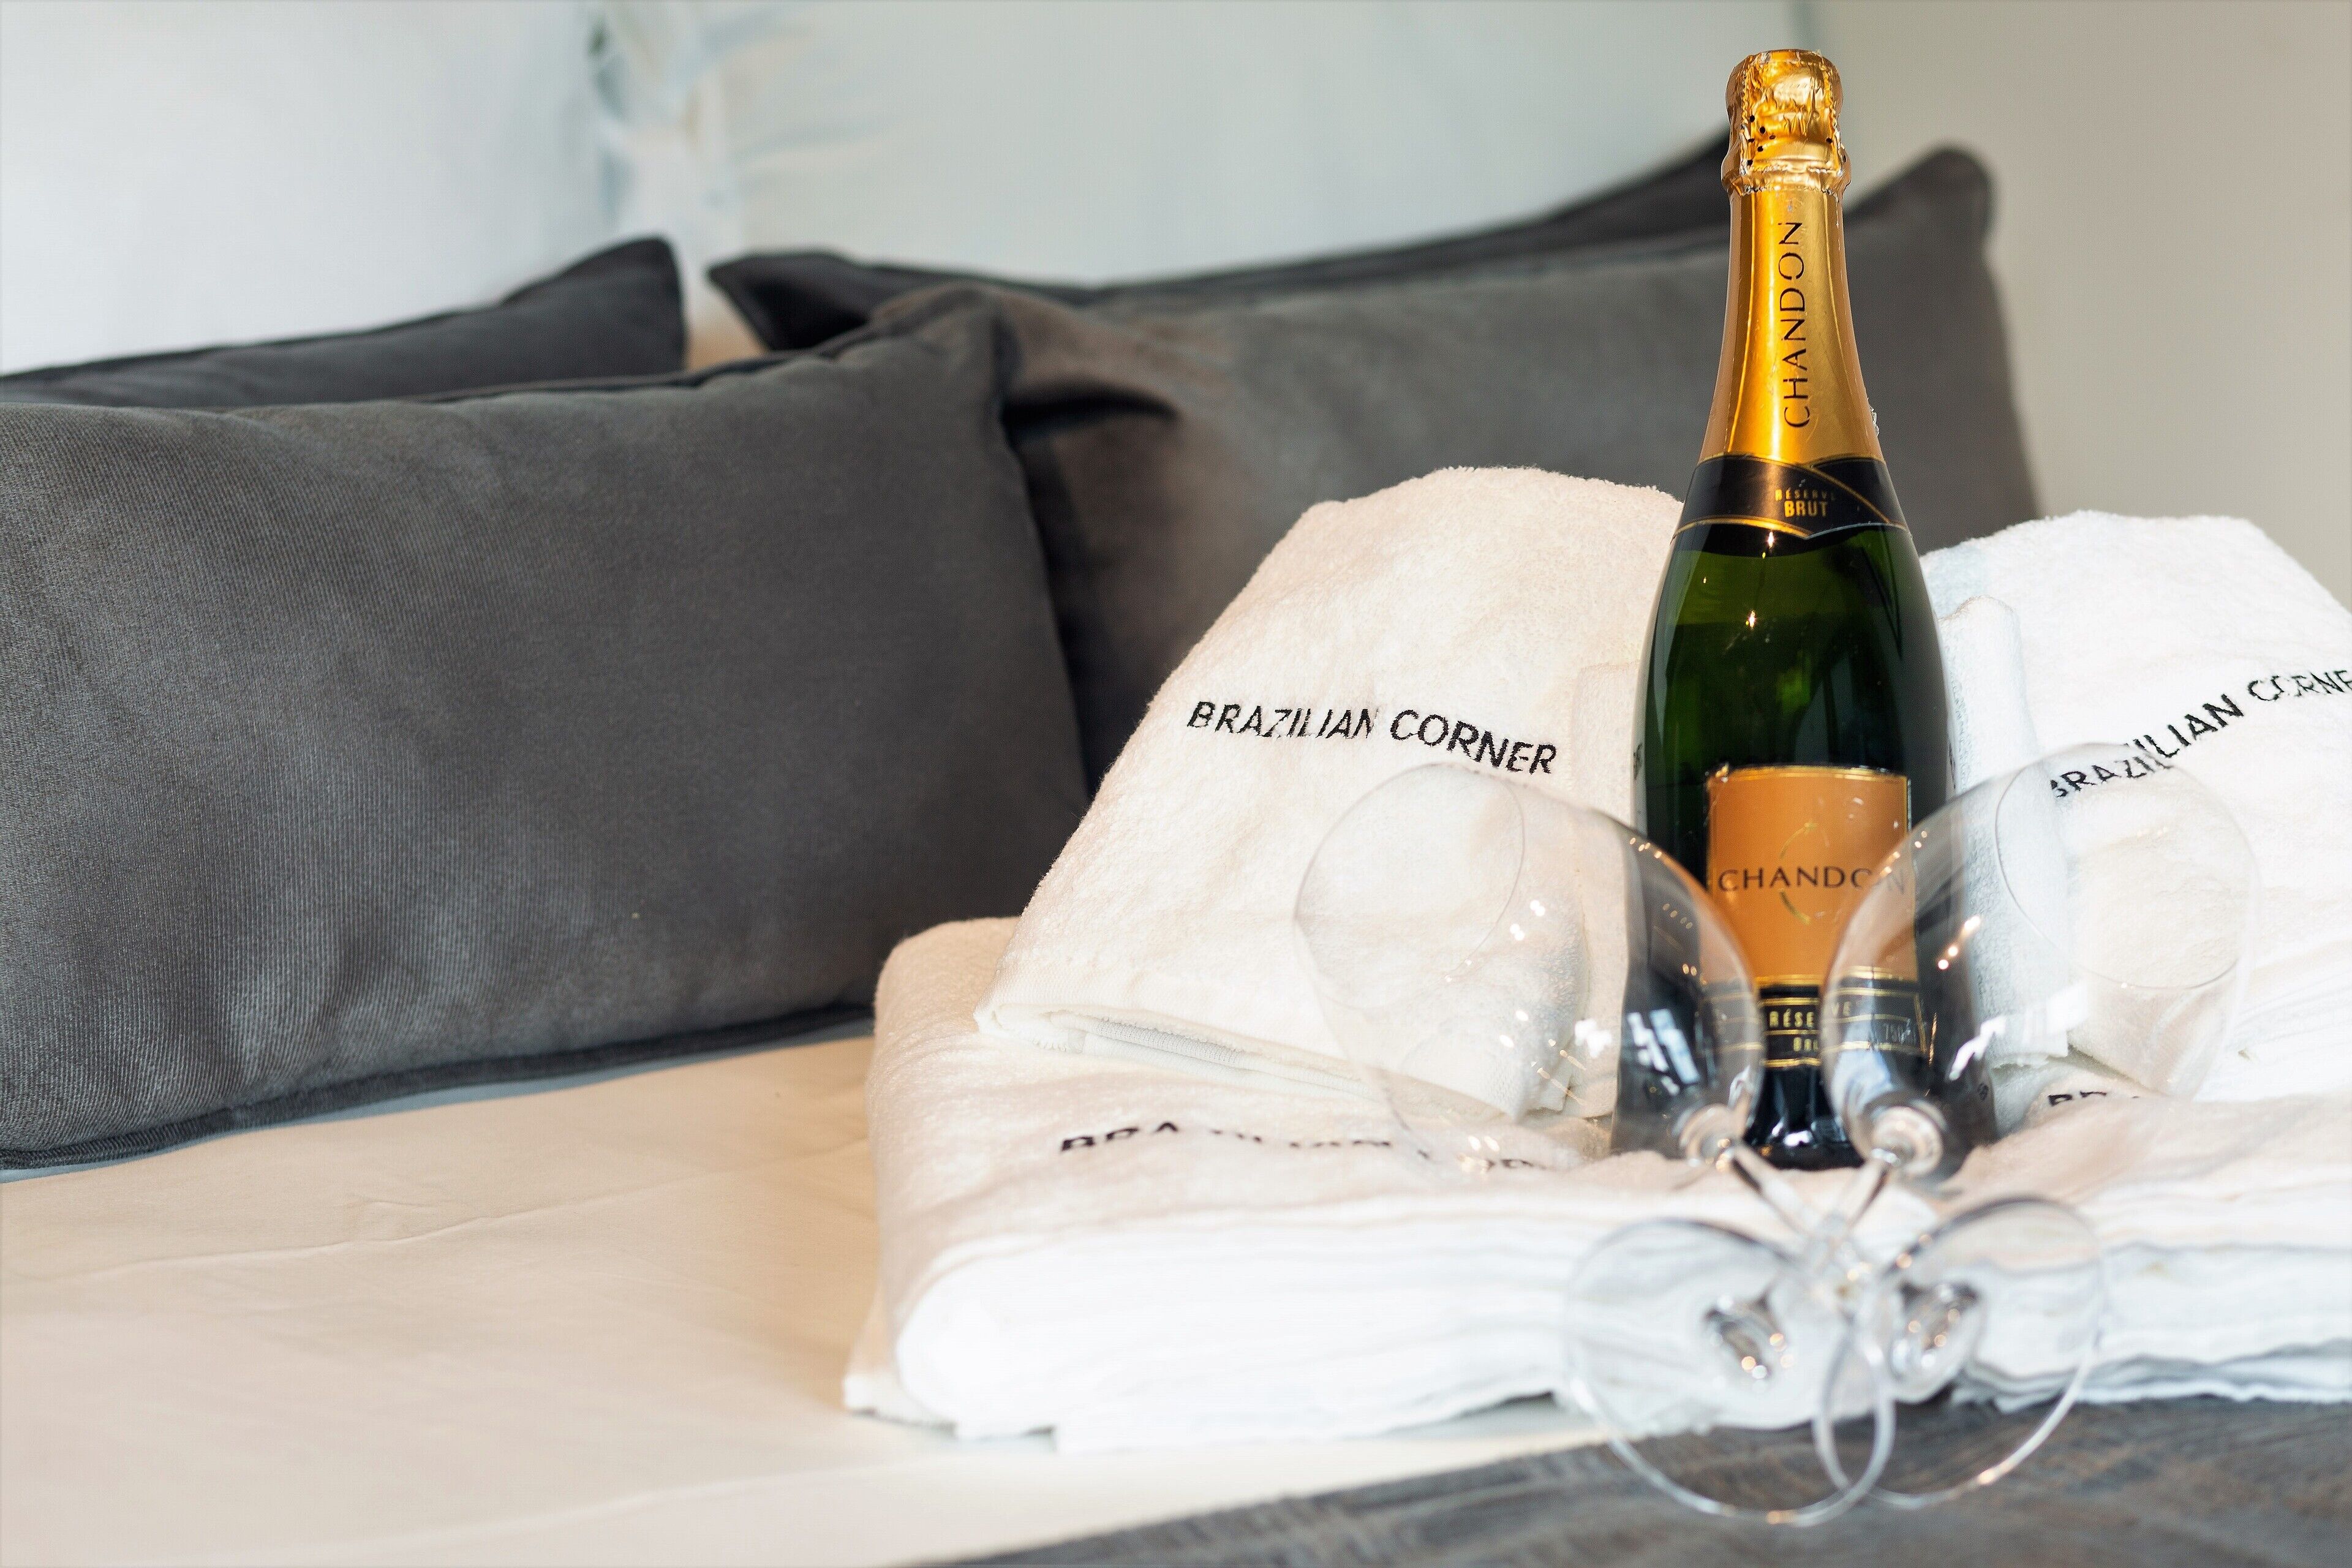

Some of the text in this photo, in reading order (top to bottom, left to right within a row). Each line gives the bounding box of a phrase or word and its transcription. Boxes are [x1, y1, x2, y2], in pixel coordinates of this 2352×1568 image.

[1777, 222, 1811, 428] CHANDON
[1784, 500, 1828, 518] BRUT
[1186, 701, 1558, 775] BRAZILIAN CORNER
